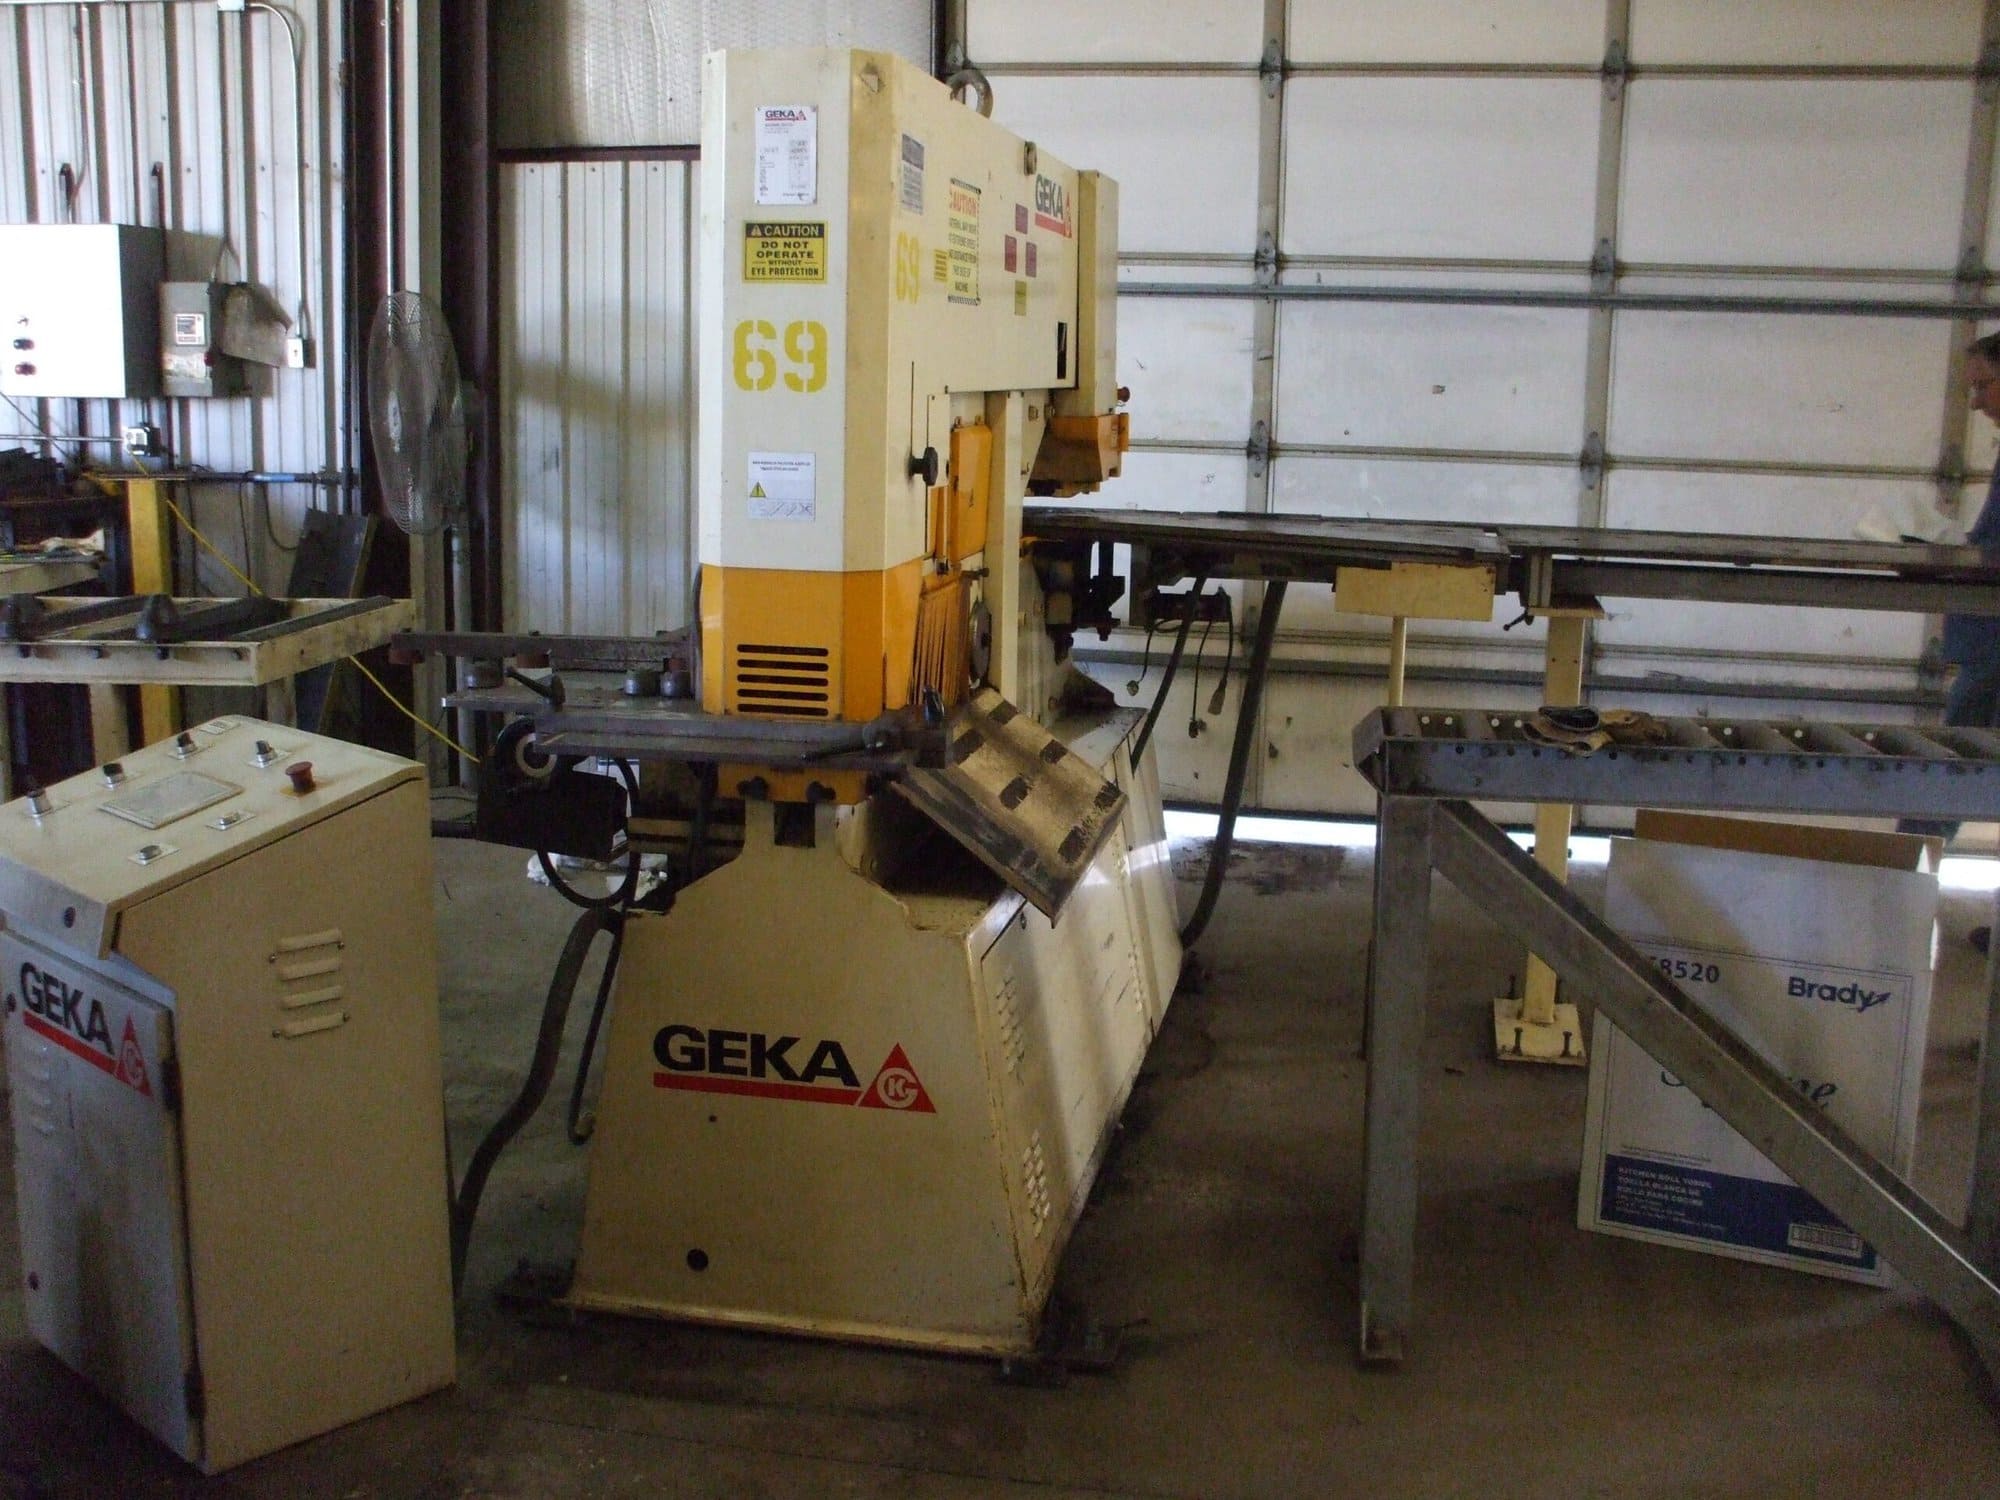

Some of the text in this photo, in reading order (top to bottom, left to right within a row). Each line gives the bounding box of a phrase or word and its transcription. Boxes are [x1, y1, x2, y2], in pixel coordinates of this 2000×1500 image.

[765, 110, 795, 118] GEKA
[1035, 173, 1063, 220] GEKA
[761, 241, 808, 249] DO NOT
[764, 224, 819, 236] CAUTION
[751, 267, 819, 276] EYE PROTECTION
[756, 251, 814, 259] OPERATE
[896, 231, 920, 304] 69
[733, 320, 828, 393] 69
[20, 961, 115, 1056] GEKA
[1787, 976, 1891, 1014] Brady
[653, 1024, 861, 1087] GEKA
